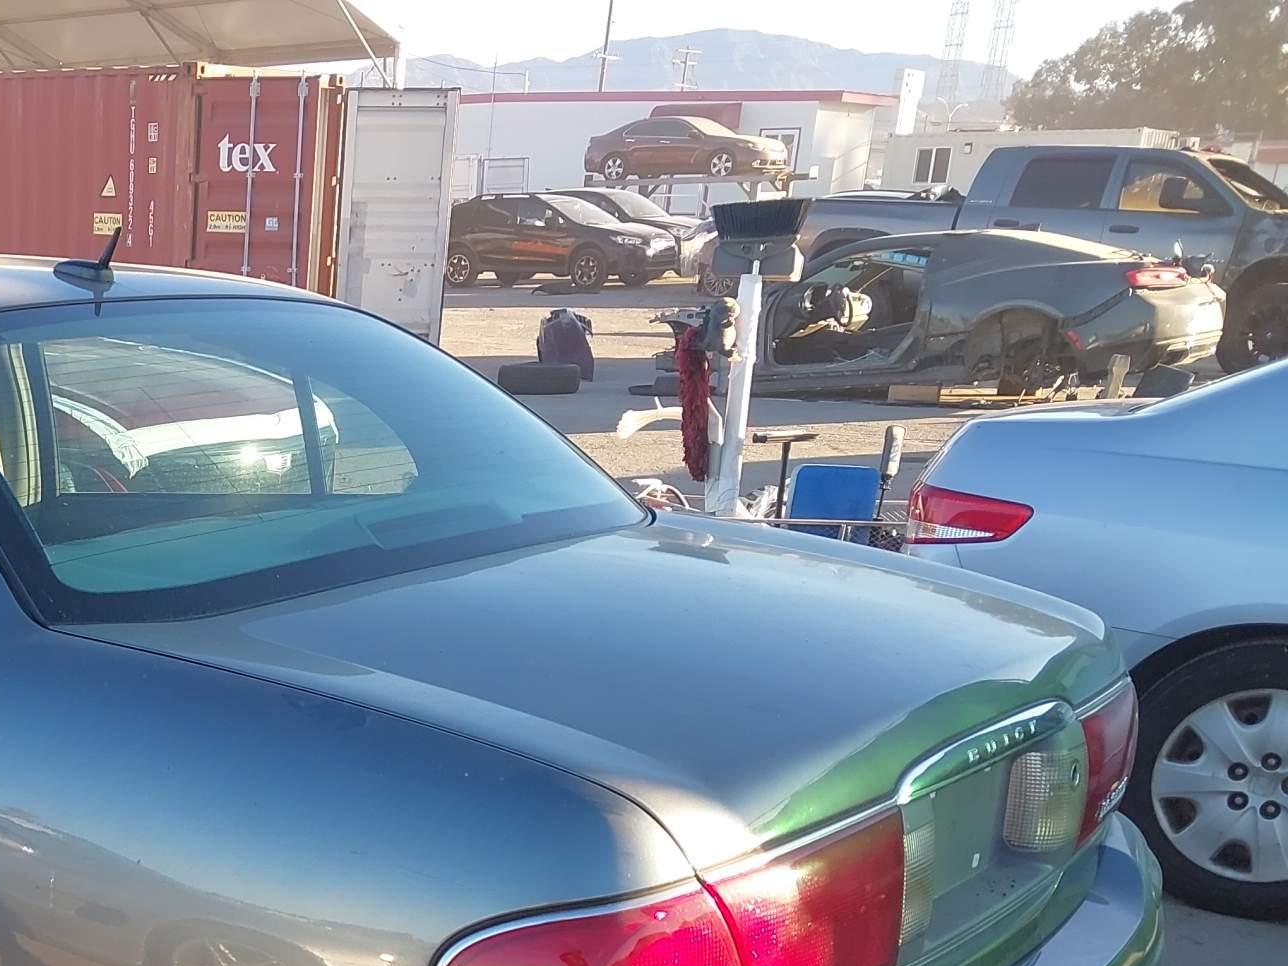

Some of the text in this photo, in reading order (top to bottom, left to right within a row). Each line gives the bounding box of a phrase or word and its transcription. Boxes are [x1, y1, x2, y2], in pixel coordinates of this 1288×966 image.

[217, 133, 278, 172] tex
[94, 216, 121, 225] CAUTON
[209, 213, 247, 223] CAUTION
